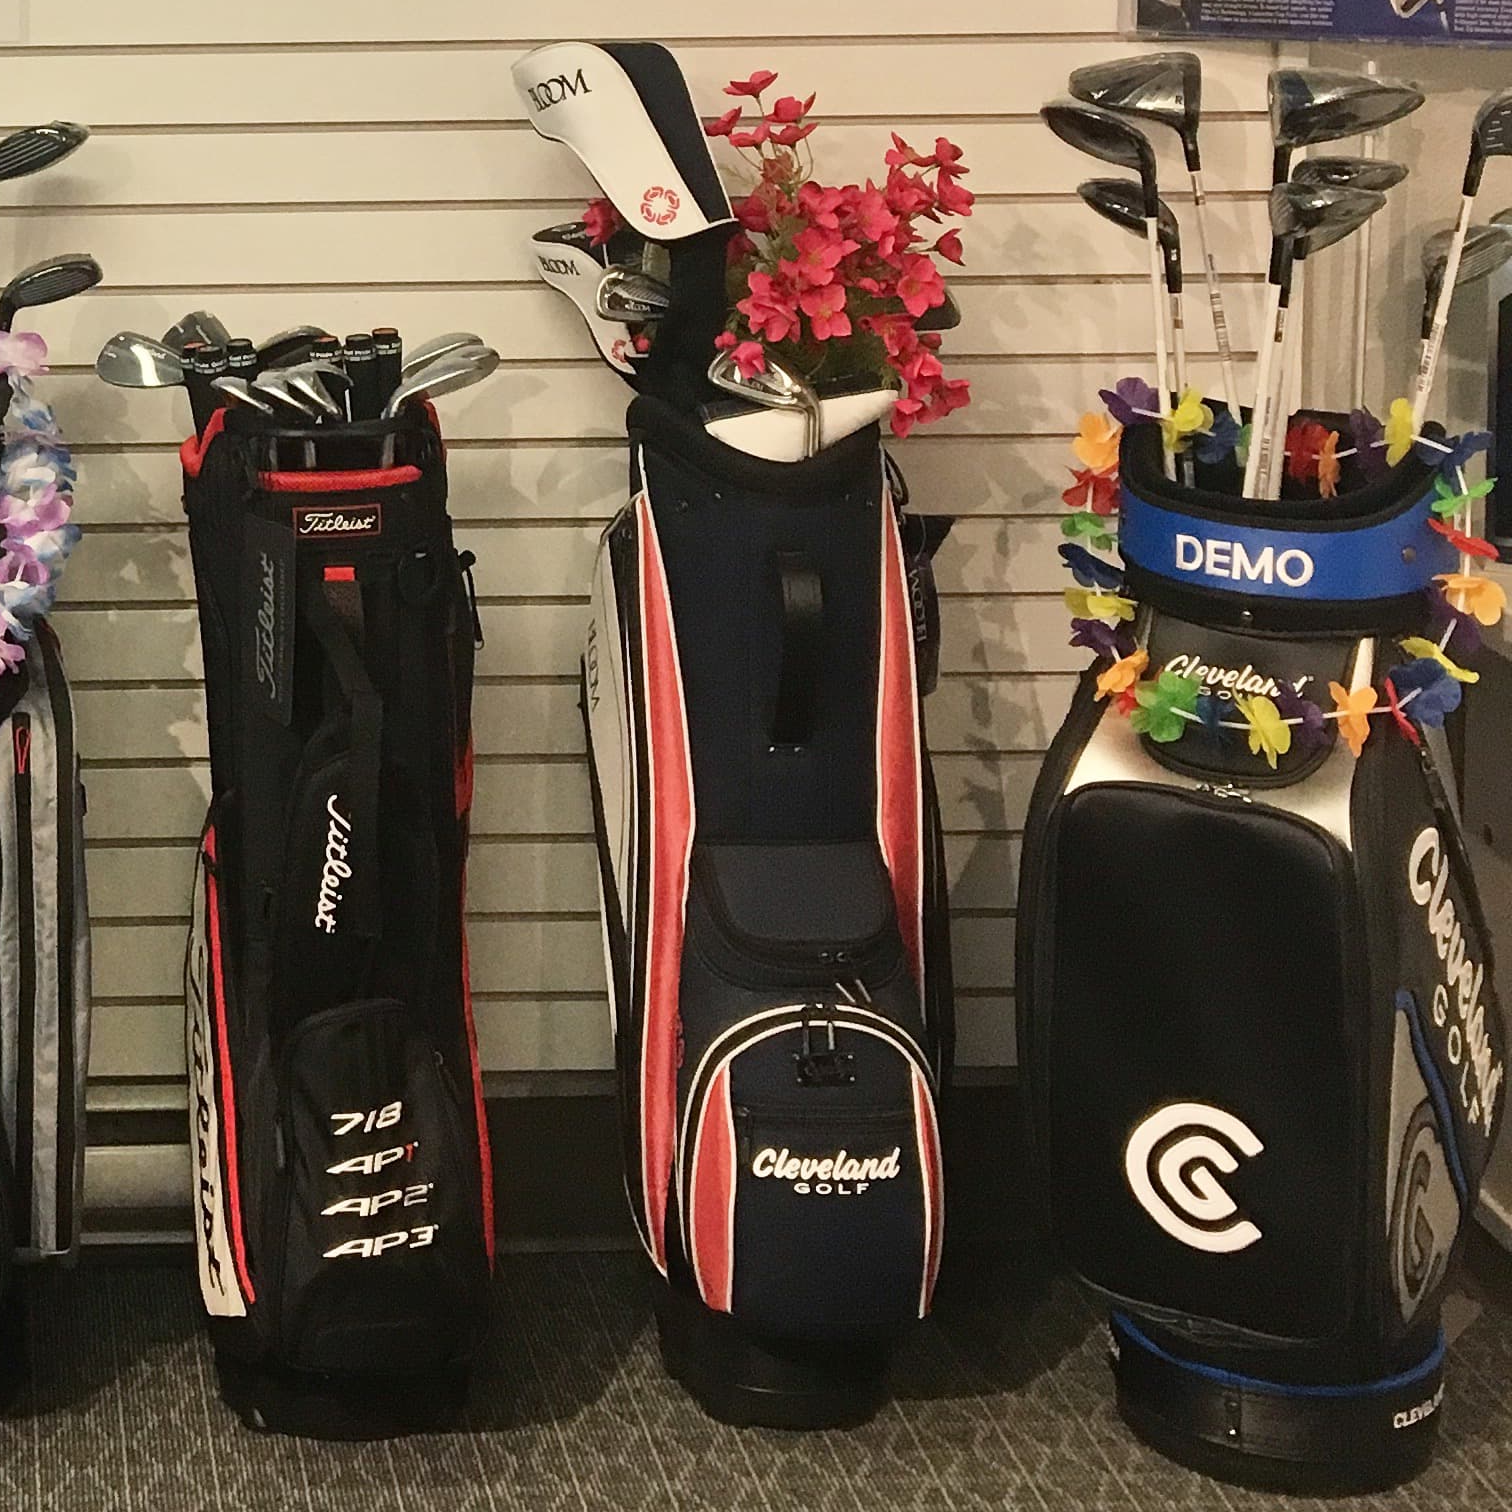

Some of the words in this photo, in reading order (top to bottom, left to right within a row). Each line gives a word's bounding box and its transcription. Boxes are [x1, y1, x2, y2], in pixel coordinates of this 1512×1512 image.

[299, 512, 375, 534] Titleist
[1175, 533, 1314, 588] DEMO
[255, 551, 277, 699] Titleist
[1408, 826, 1504, 1137] Cleveland
[330, 1101, 402, 1136] 718
[326, 1142, 417, 1175] AP1
[752, 1147, 901, 1181] Cleveland
[320, 1185, 432, 1217] AP2
[793, 1182, 870, 1196] GOLF
[322, 1226, 438, 1258] AP3
[1394, 1382, 1445, 1428] CLEVEL
